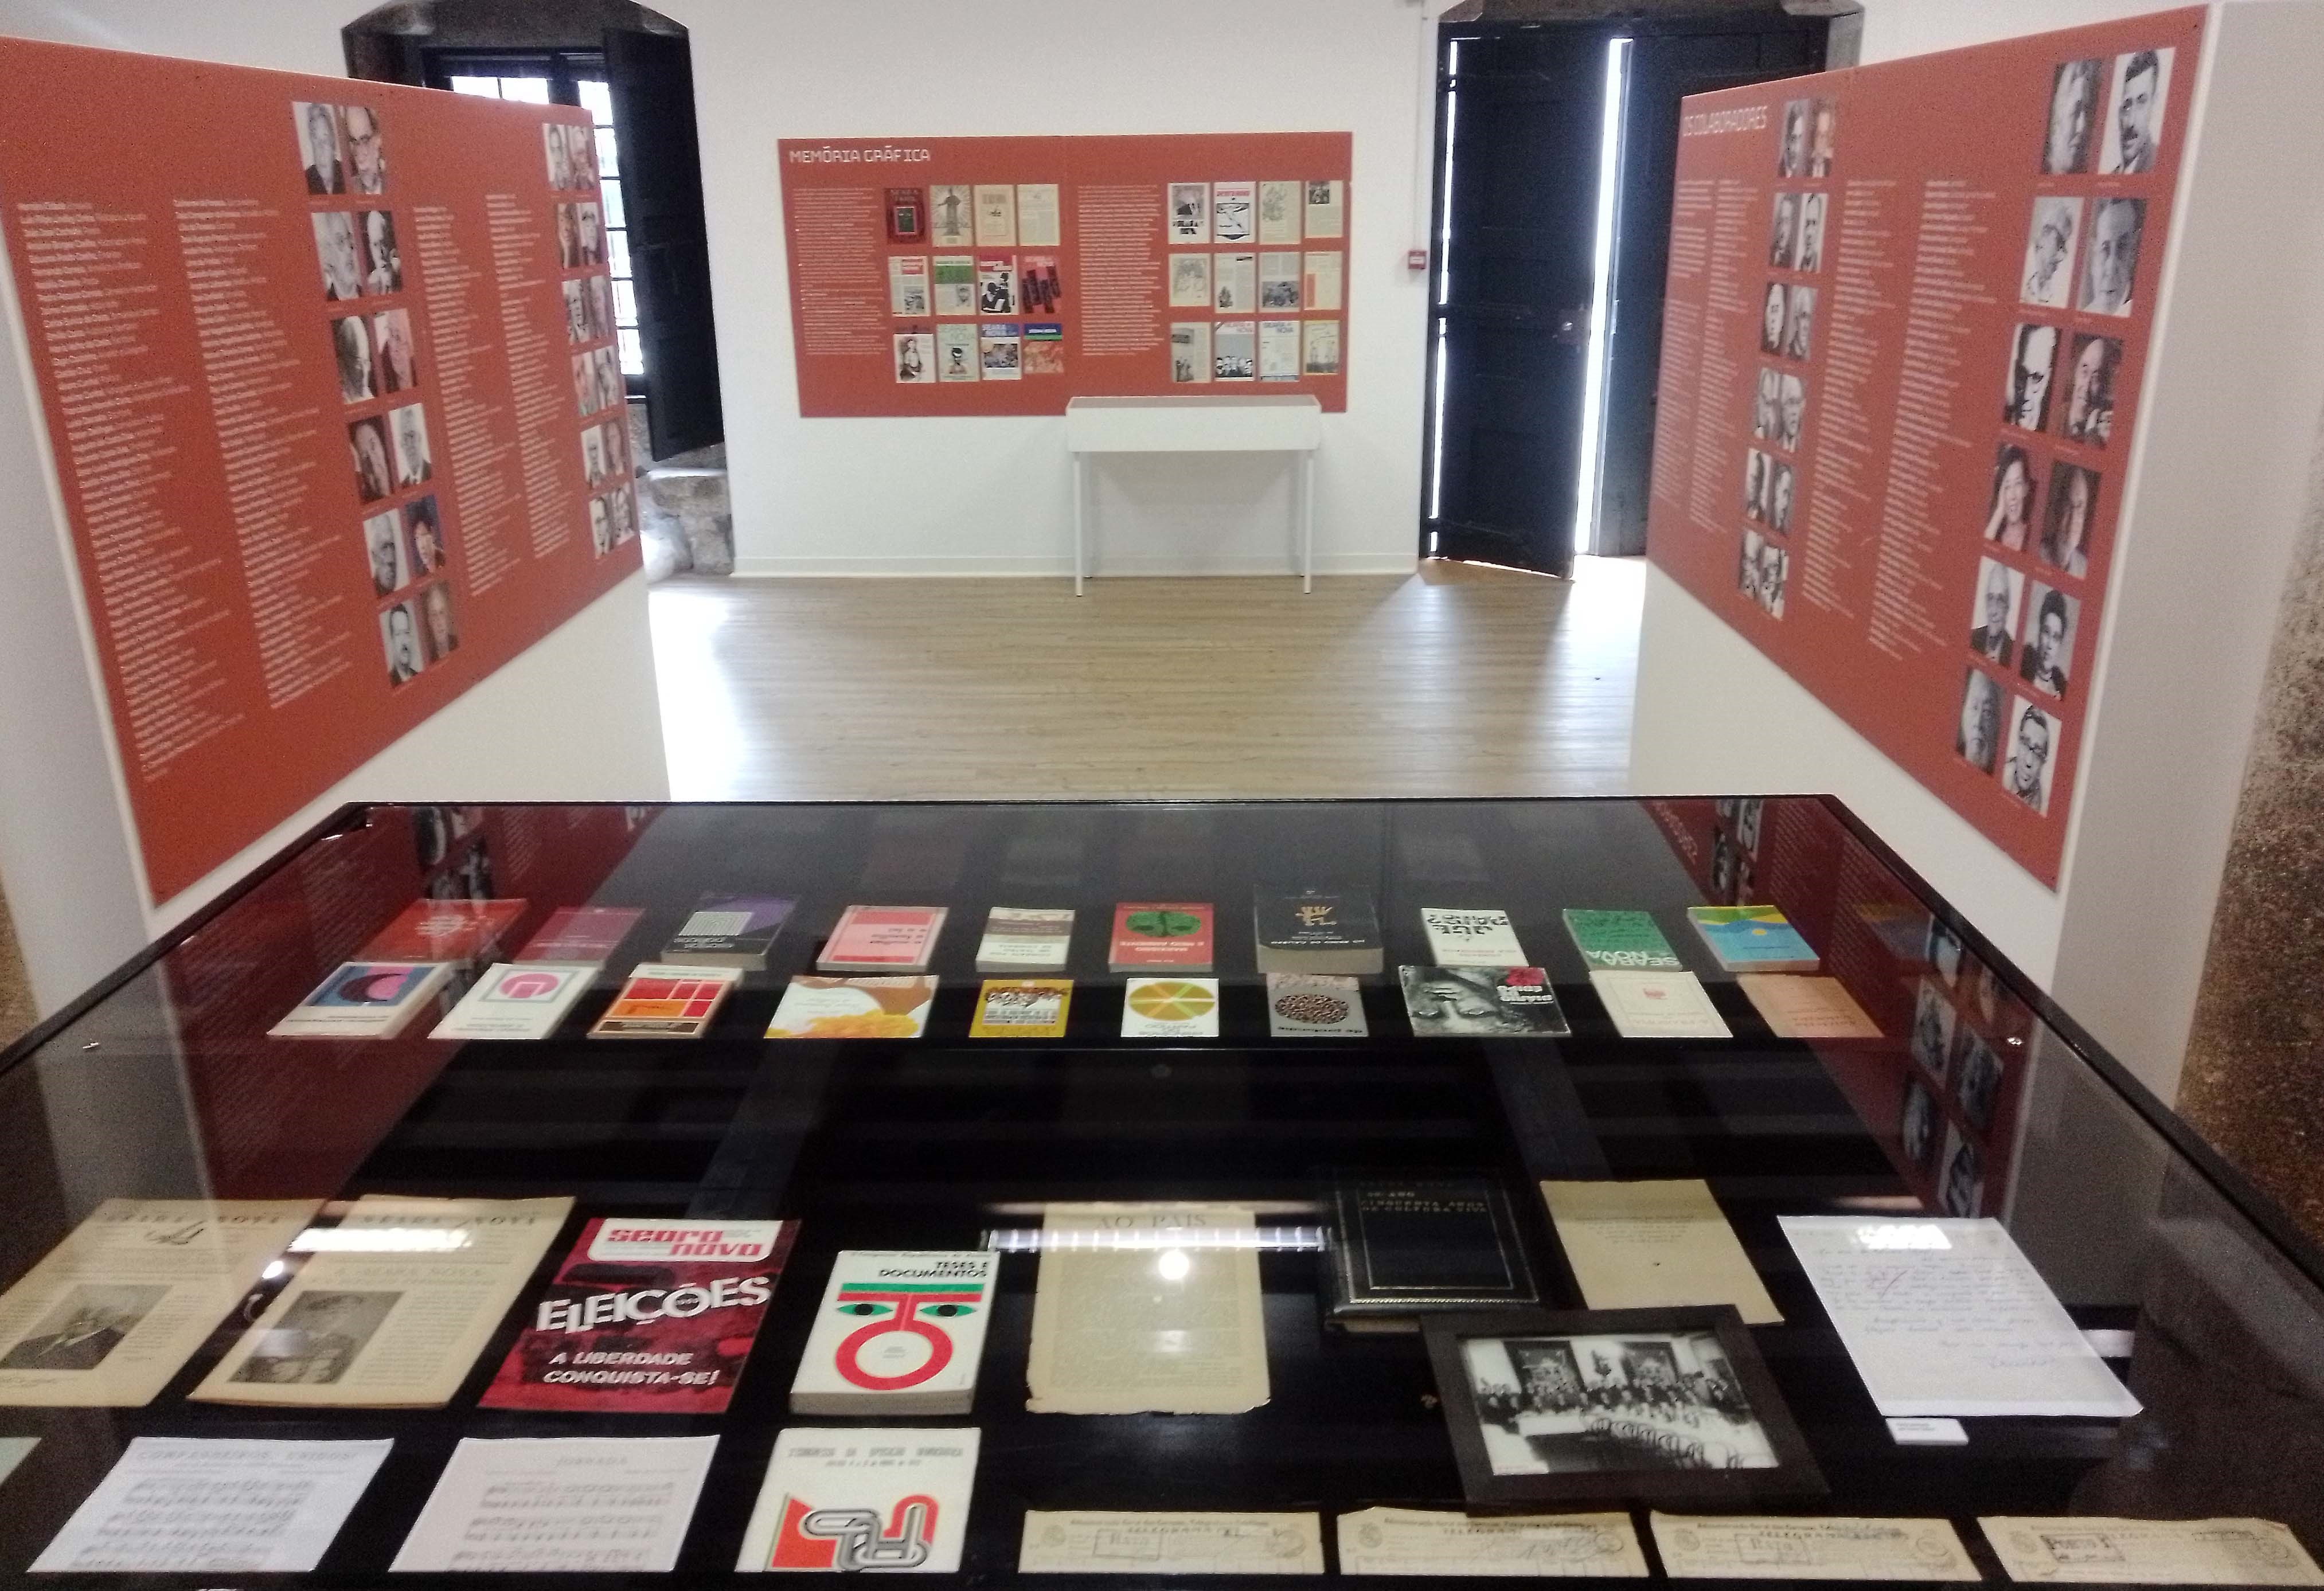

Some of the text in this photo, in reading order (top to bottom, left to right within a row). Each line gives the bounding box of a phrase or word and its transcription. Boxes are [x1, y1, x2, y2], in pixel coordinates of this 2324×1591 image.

[789, 145, 931, 163] MEMÓRIA GRÁFICA
[607, 1228, 724, 1242] seara
[670, 1243, 763, 1256] nova
[936, 1261, 988, 1269] TESES E
[879, 1269, 987, 1277] DOCUMENTOS
[536, 1276, 772, 1334] ELEIÇÕES
[549, 1351, 694, 1366] A LIBERDADE
[543, 1369, 720, 1385] CONQUISTA-SE!
